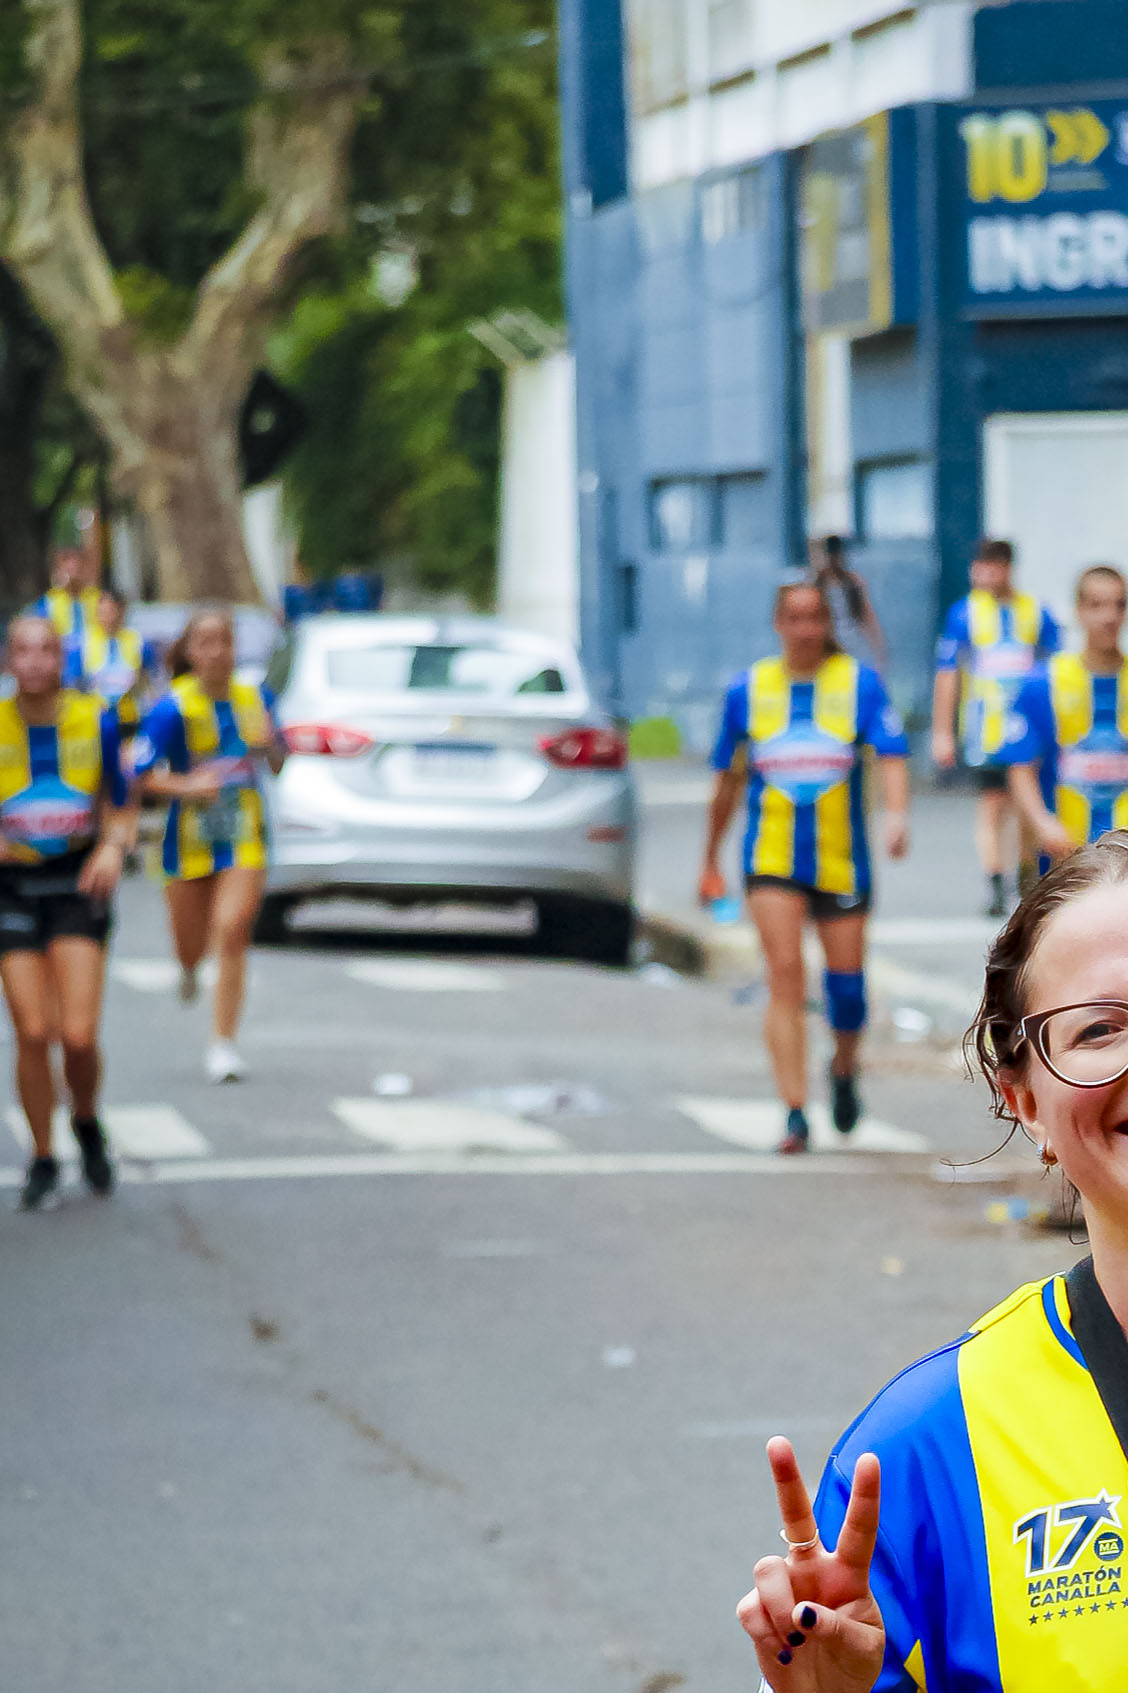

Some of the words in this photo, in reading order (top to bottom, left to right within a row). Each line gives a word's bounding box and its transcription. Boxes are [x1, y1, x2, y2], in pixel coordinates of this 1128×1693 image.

[961, 110, 1047, 203] 10
[1014, 1490, 1120, 1577] 17
[1027, 1565, 1122, 1596] MARATÓN
[1029, 1581, 1122, 1608] CANALLA
